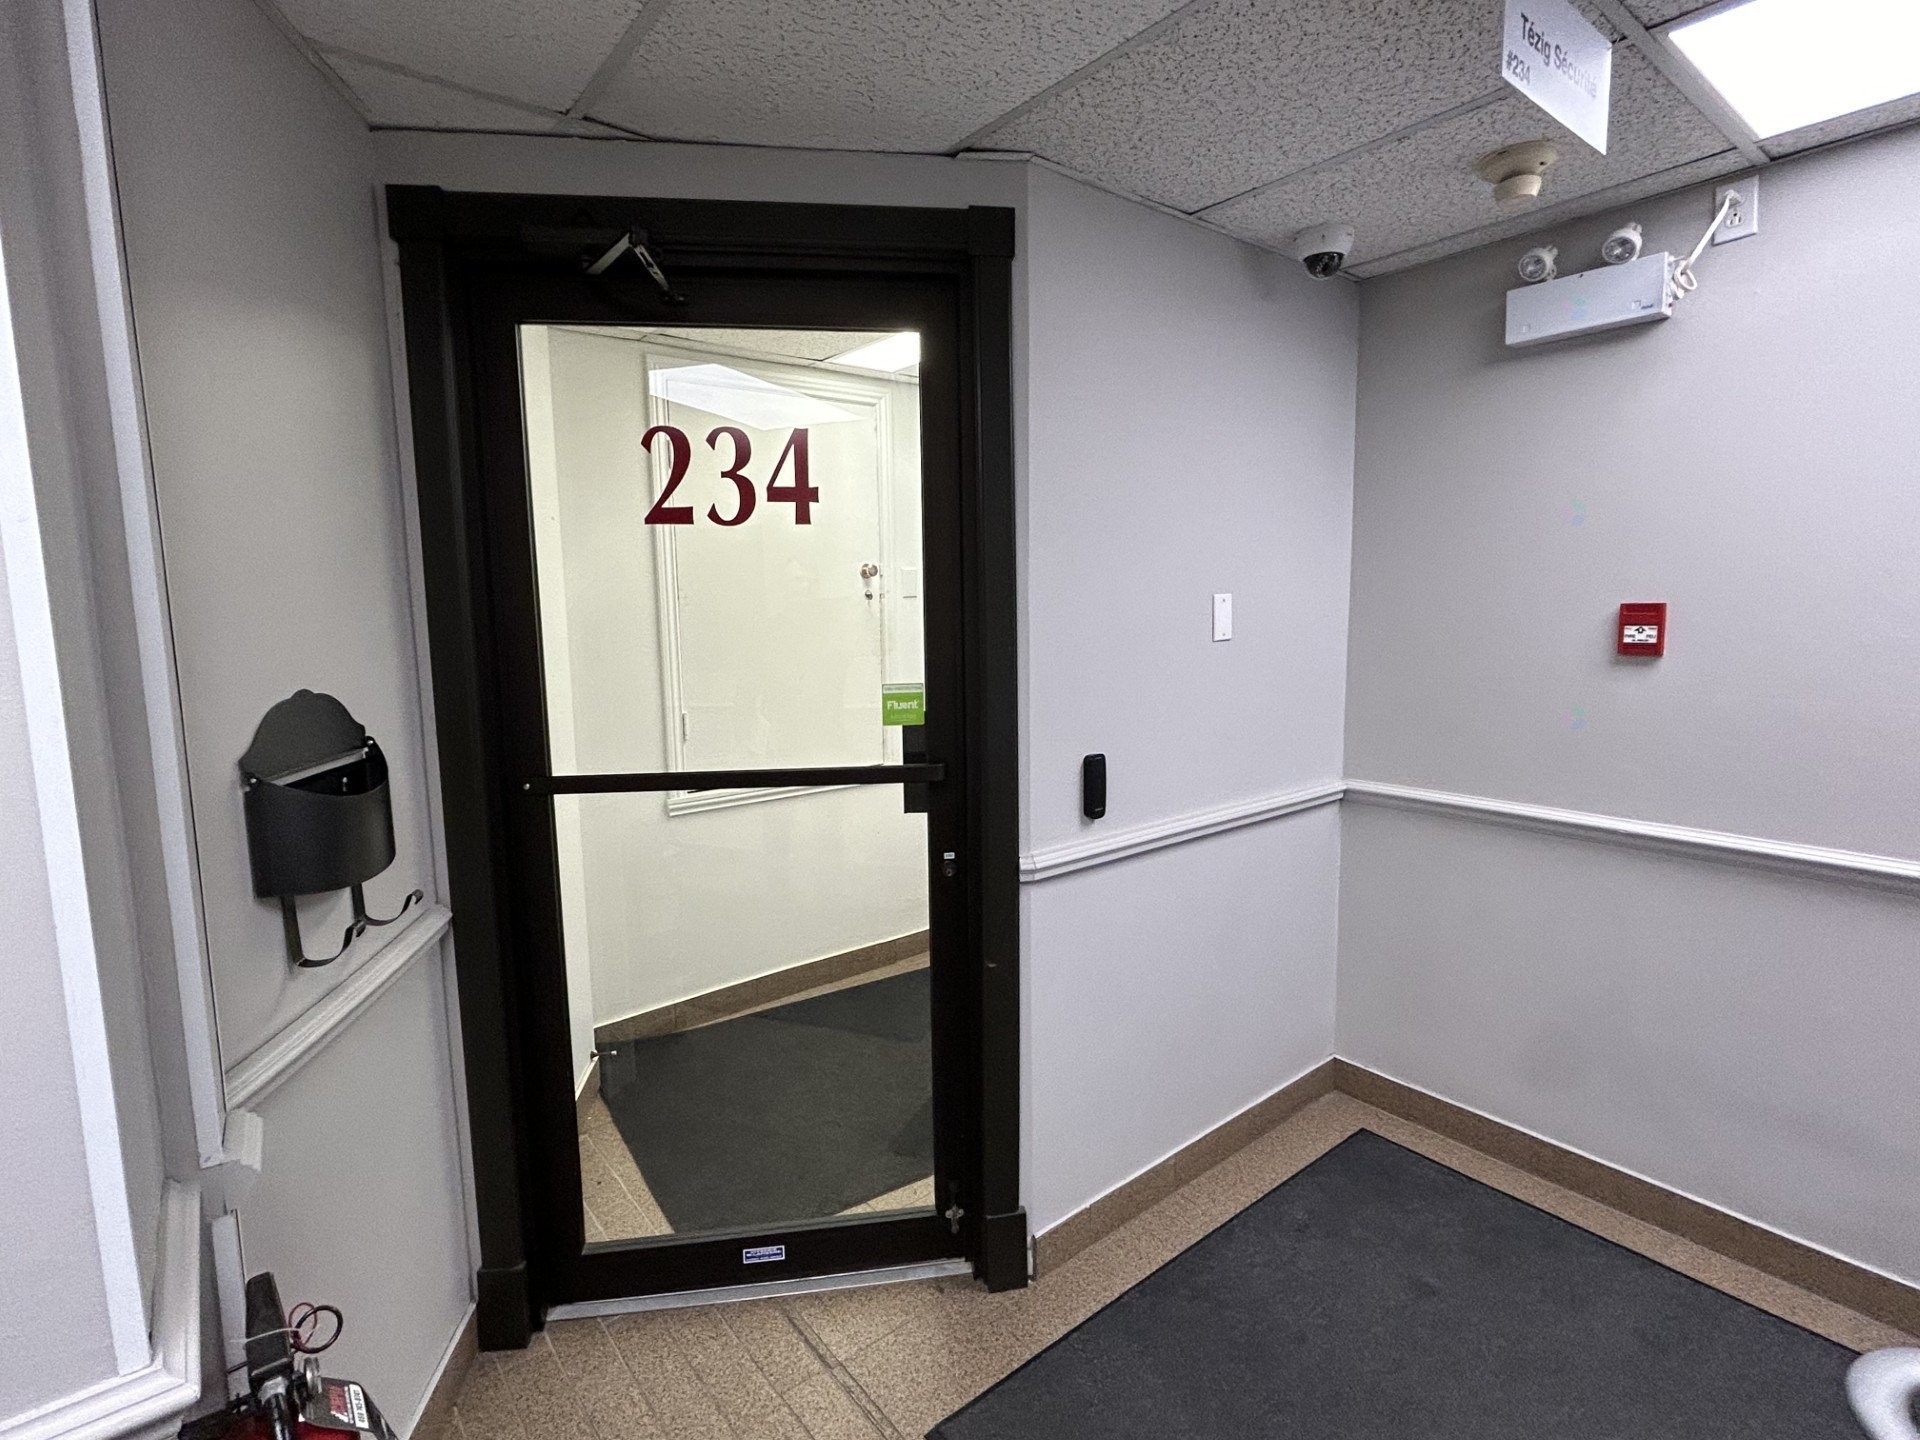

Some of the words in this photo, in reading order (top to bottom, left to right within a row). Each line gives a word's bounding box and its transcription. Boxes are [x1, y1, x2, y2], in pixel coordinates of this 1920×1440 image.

[1506, 49, 1531, 86] #234
[1520, 12, 1551, 67] Tézig
[1553, 44, 1597, 99] Sécurité
[641, 425, 819, 527] 234
[887, 698, 919, 711] Fluent
